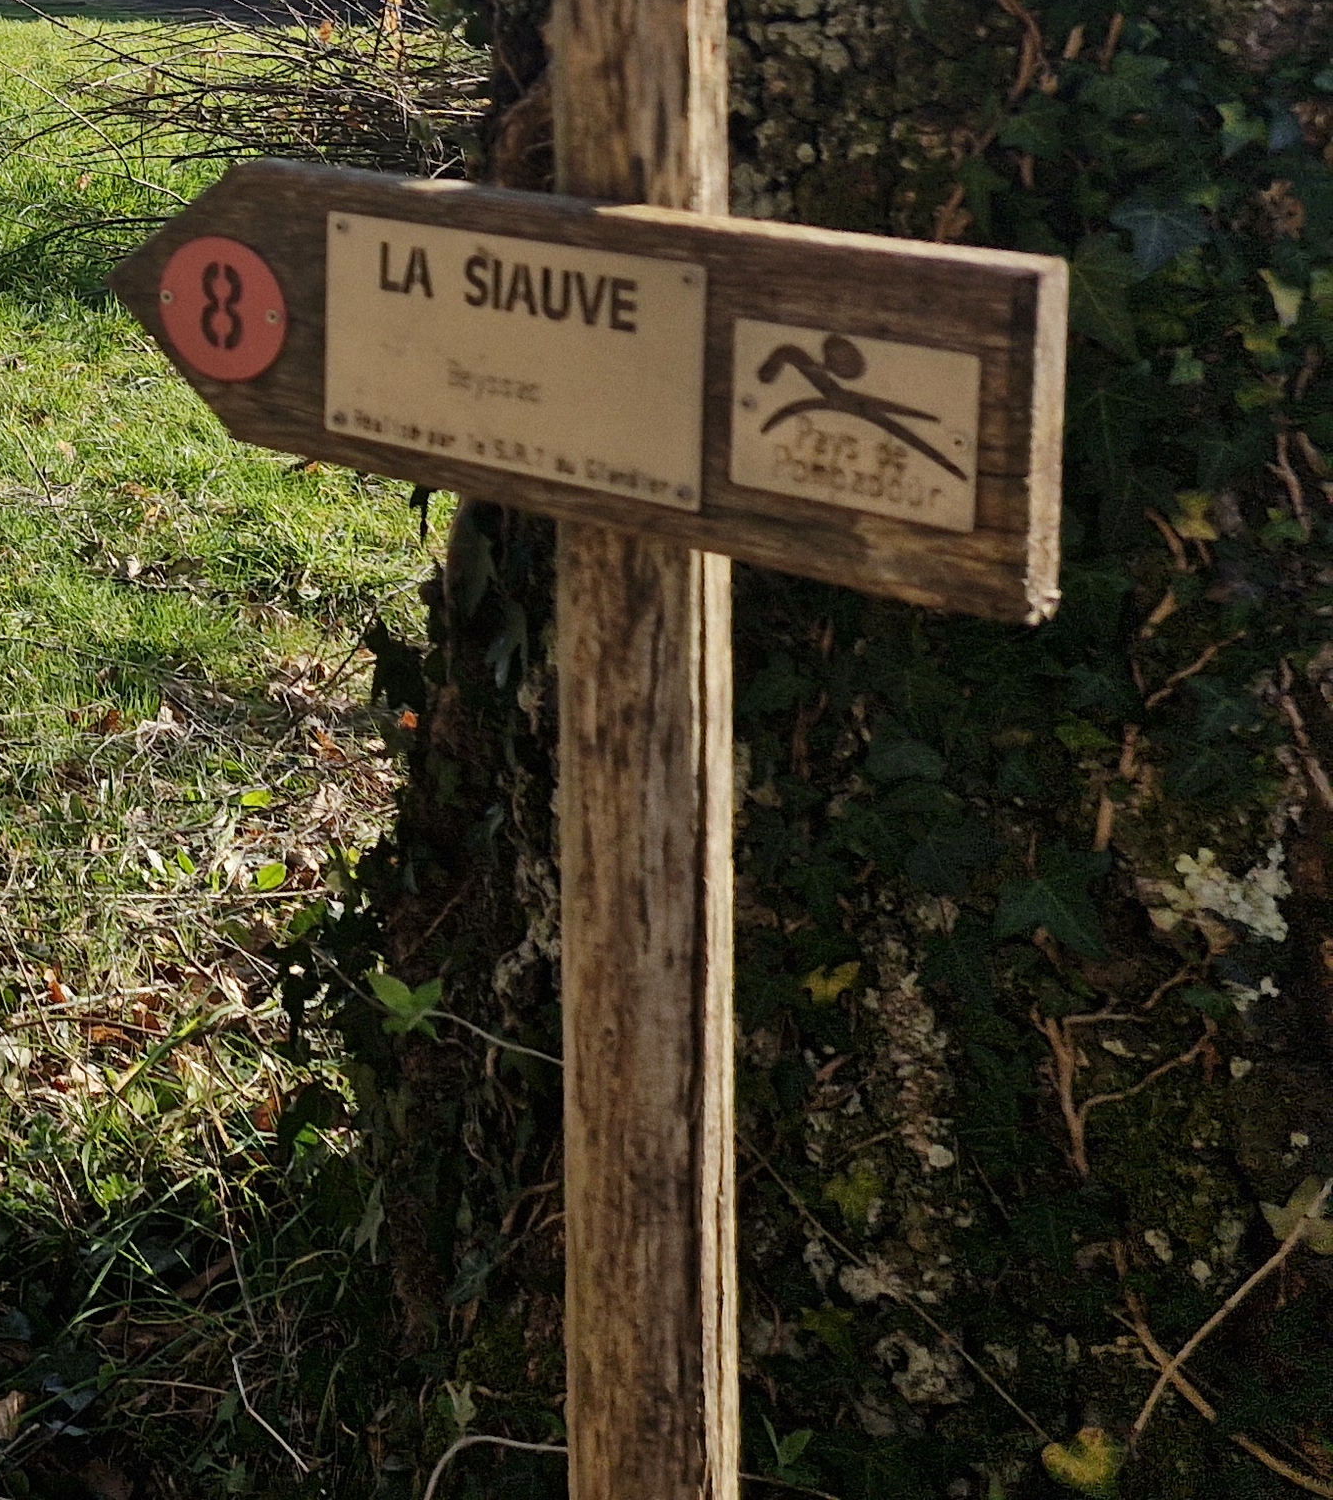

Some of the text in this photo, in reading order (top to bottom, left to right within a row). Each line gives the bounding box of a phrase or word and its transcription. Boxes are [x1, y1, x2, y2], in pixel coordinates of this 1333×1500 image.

[201, 260, 244, 351] 8
[379, 240, 638, 334] LA SIAUVE
